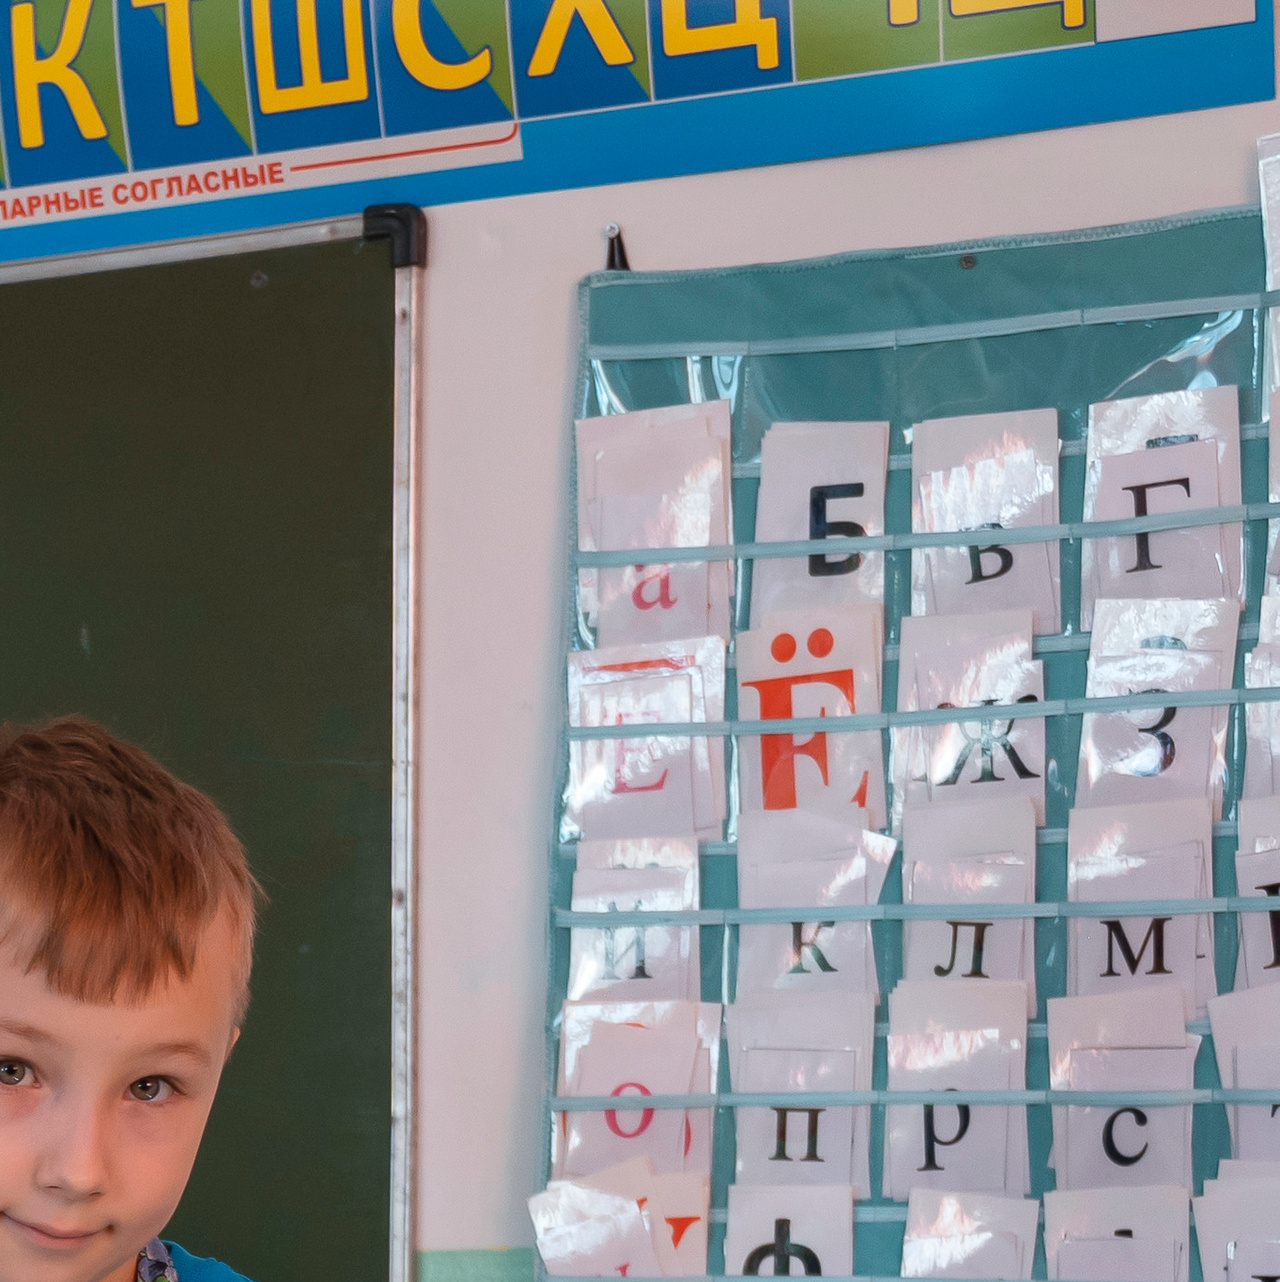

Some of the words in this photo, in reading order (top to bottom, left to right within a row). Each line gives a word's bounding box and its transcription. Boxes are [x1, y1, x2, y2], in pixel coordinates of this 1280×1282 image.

[111, 161, 284, 208] СОГЛАСНЫЕ
[808, 482, 866, 577] Б
[1122, 478, 1191, 573] Г
